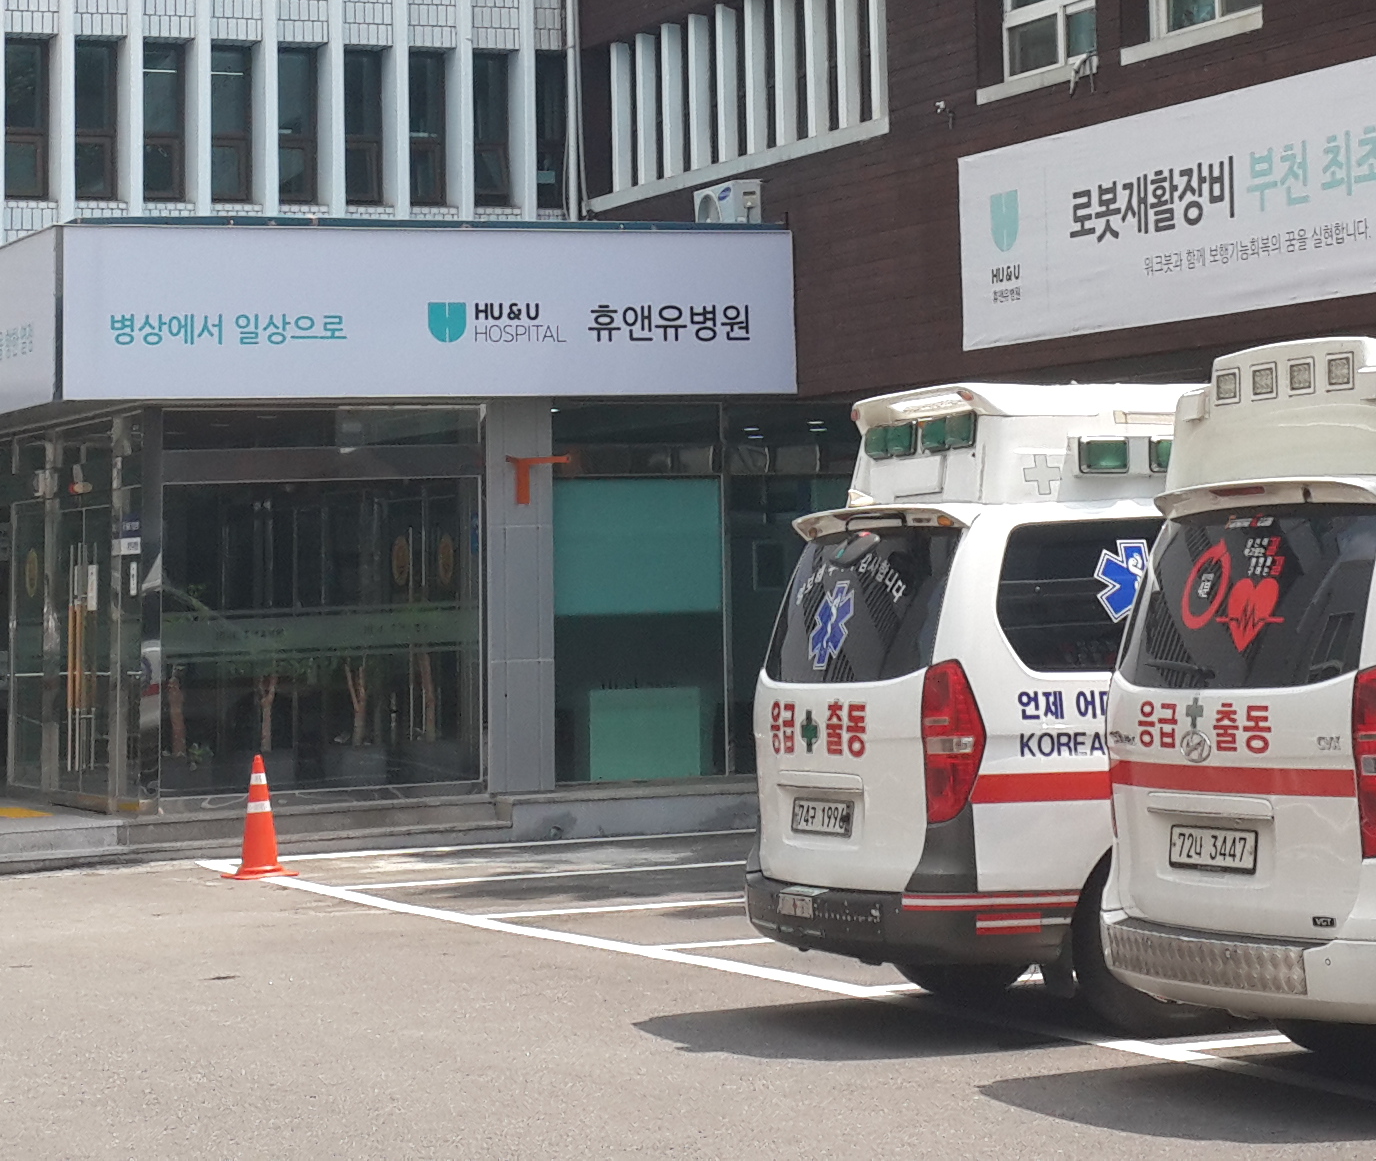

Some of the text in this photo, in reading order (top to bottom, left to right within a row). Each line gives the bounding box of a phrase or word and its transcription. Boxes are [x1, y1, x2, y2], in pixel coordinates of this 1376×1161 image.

[1070, 155, 1235, 244] 로봇재활장비
[1245, 139, 1311, 212] 부천
[1186, 246, 1207, 270] 함께
[1209, 233, 1281, 265] 보행기능회복의
[1285, 228, 1308, 253] 꿈을
[1311, 217, 1372, 249] 실현합니다.
[991, 263, 1021, 284] HU&U
[474, 302, 541, 321] HU&U
[587, 304, 751, 342] 휴앤유병원
[110, 313, 348, 346] 병상에서 일상으로
[474, 324, 567, 343] HOSPITAL
[1017, 690, 1065, 720] 언제
[770, 699, 867, 758] 응급 출동
[1137, 700, 1273, 754] 응급 출동
[1019, 731, 1107, 757] KOREA
[821, 805, 846, 830] 1996
[1208, 834, 1248, 863] 3447
